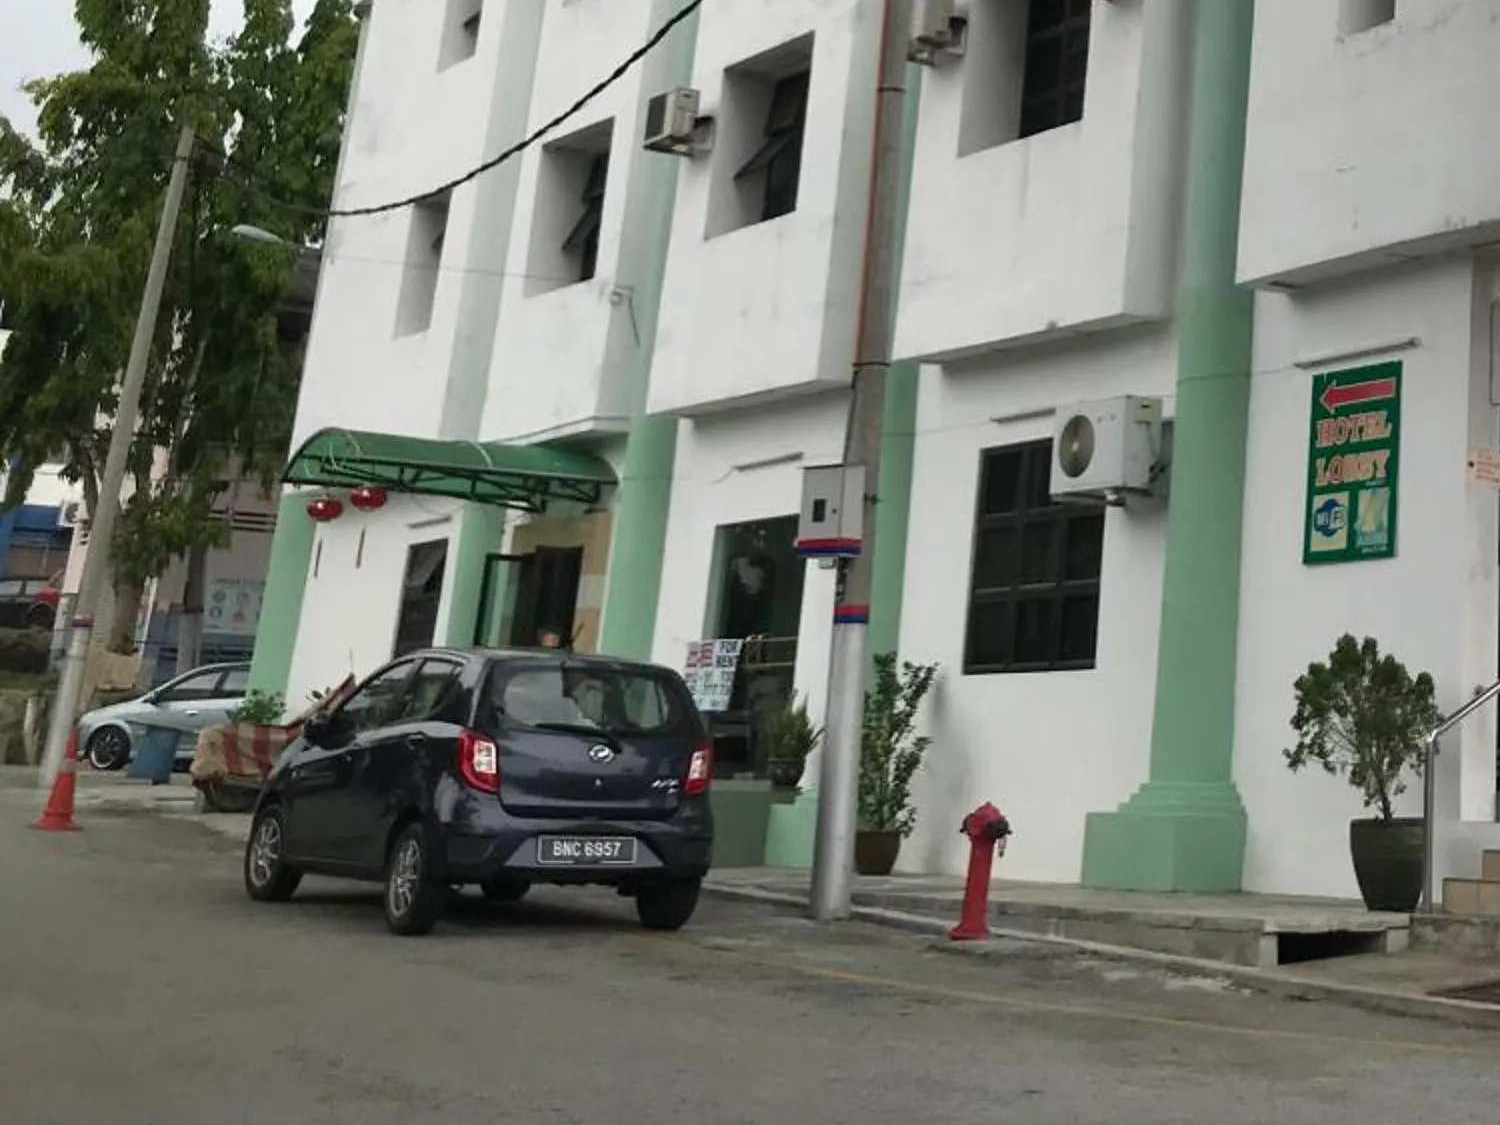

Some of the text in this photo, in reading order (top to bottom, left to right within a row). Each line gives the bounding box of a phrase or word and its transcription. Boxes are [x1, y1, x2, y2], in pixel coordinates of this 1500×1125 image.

[1315, 410, 1393, 448] HOTEL
[1315, 449, 1391, 487] LOBBY
[552, 840, 582, 858] BNC
